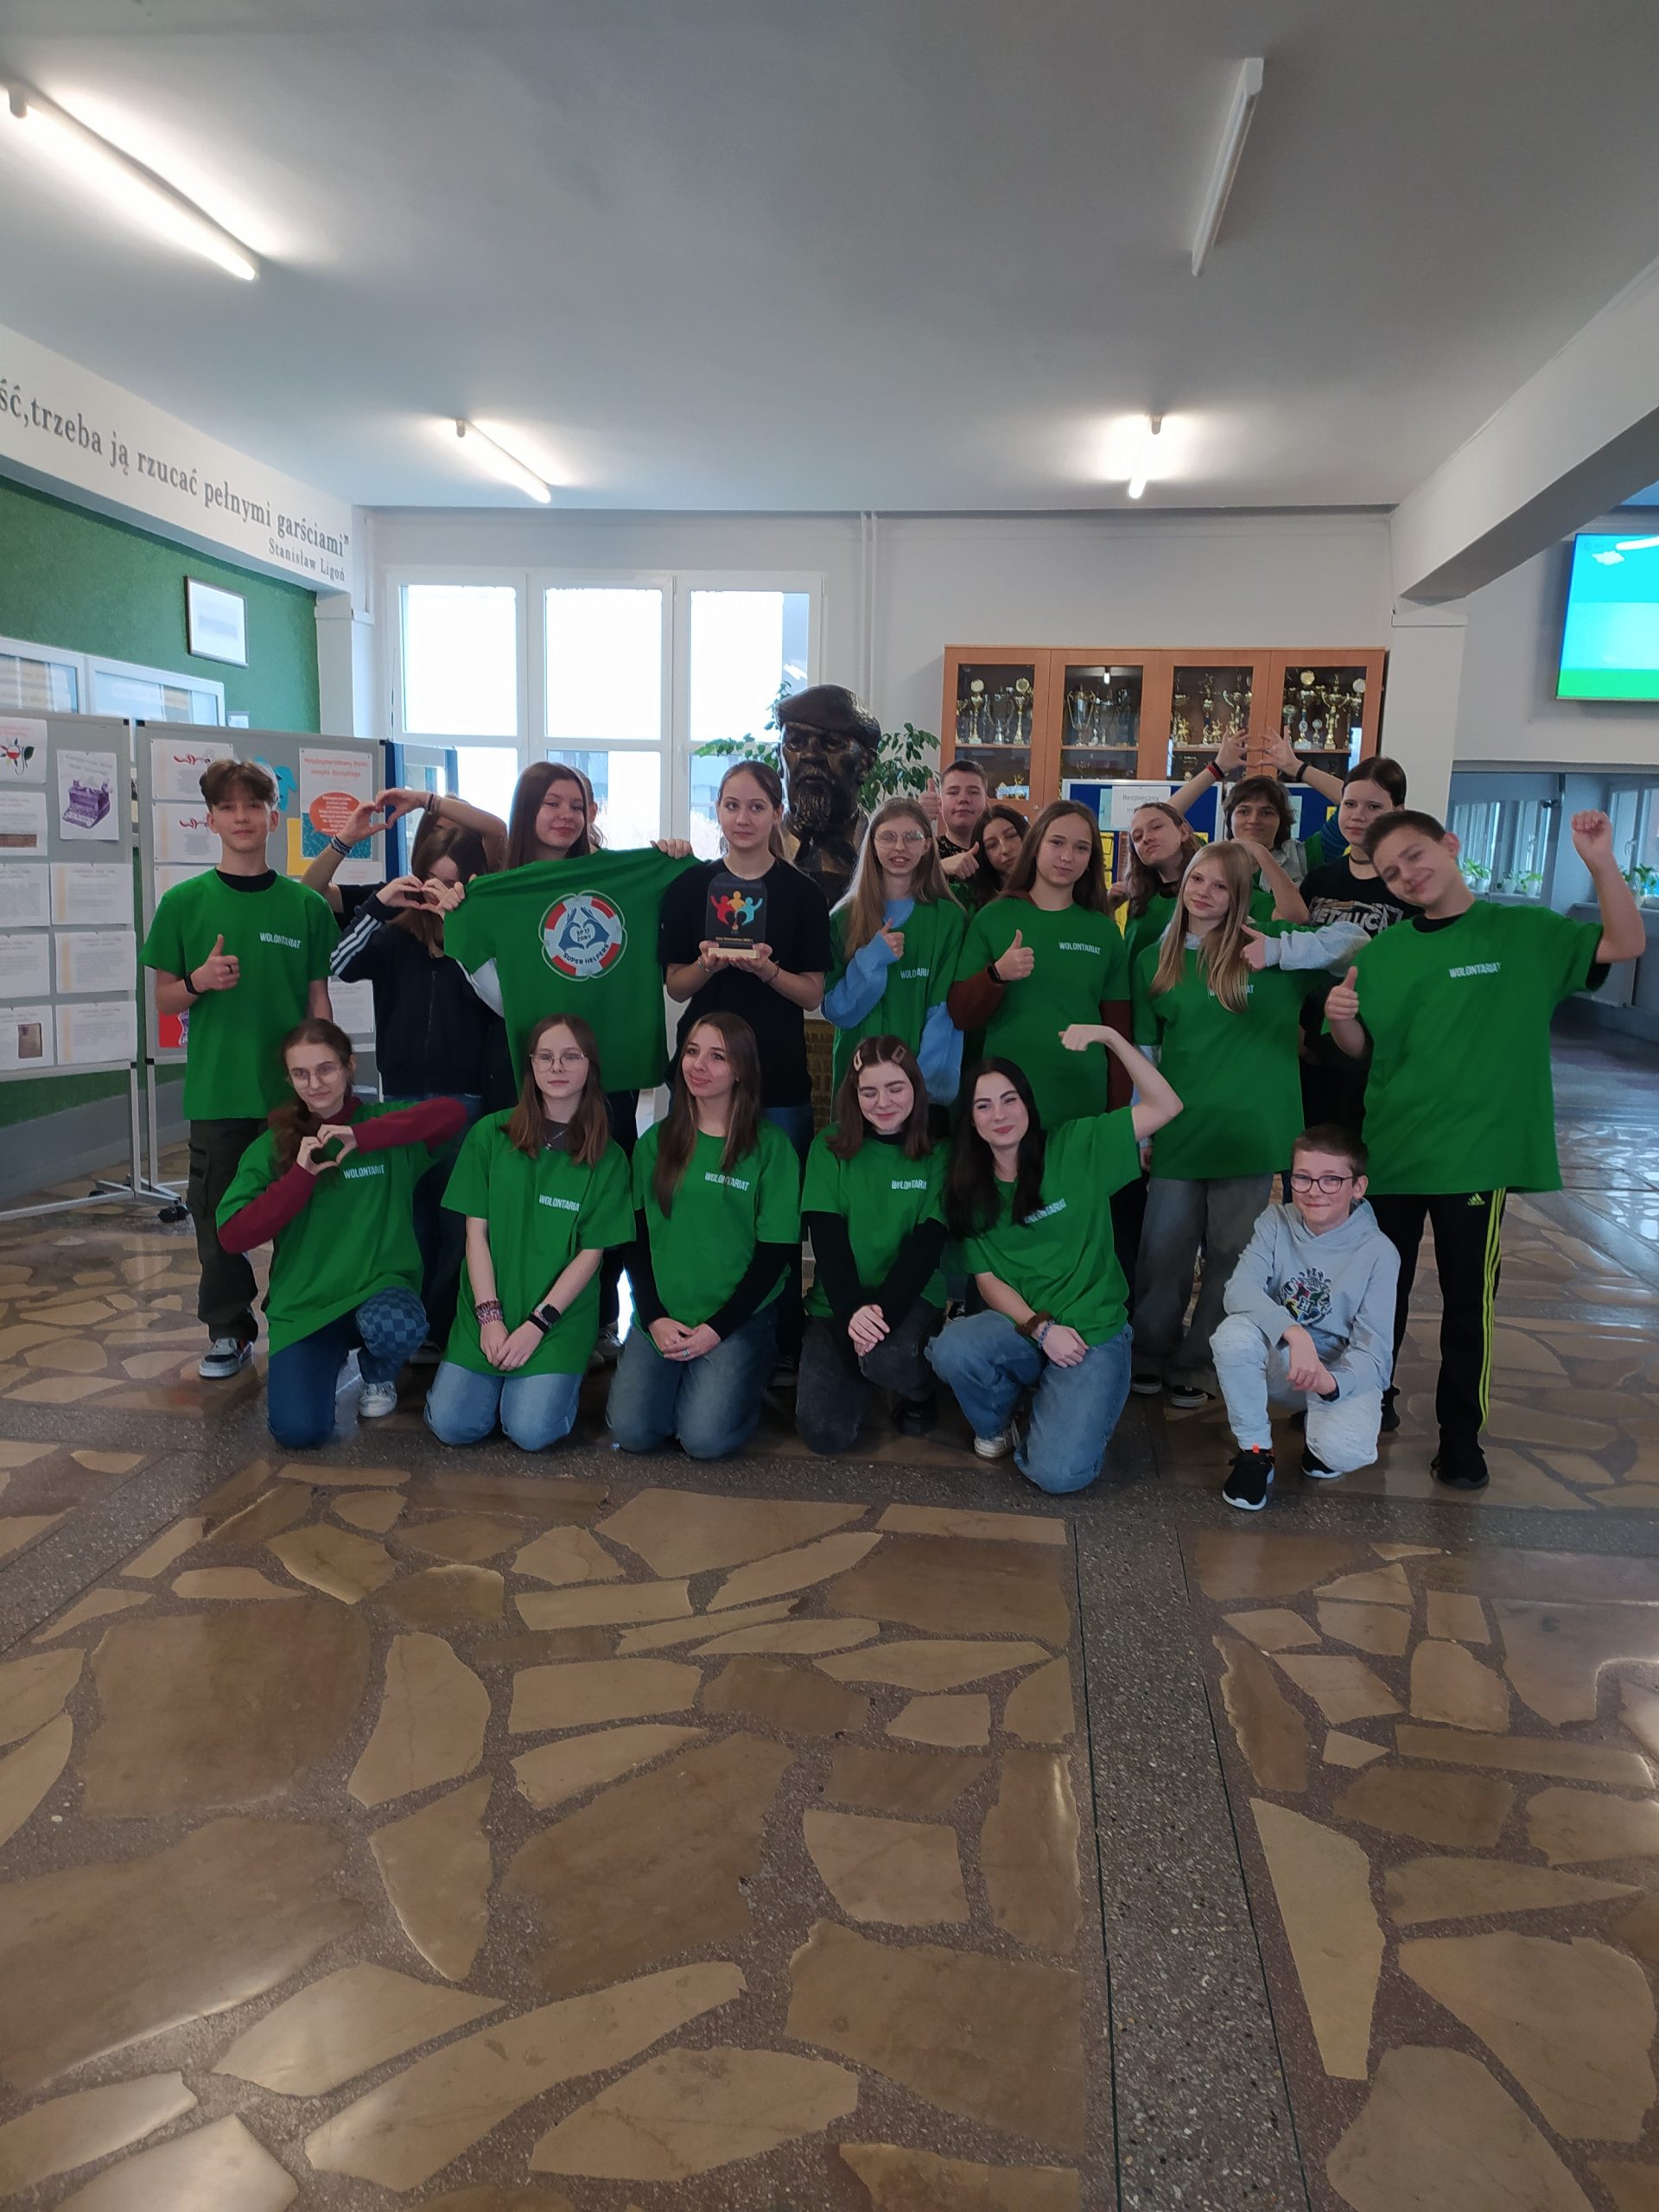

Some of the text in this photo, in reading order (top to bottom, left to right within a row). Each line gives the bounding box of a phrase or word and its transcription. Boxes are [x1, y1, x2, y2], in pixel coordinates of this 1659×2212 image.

[109, 429, 130, 477] ją
[137, 452, 198, 497] rzucać
[204, 480, 272, 527] pełnymi
[268, 537, 346, 582] Stanisław Ligoń
[259, 932, 302, 949] WOLONTARIAT
[1058, 941, 1101, 955] WOLONTARIAT
[563, 944, 610, 965] SUPER HELPERS
[538, 1193, 581, 1211] WOLONTARIA
